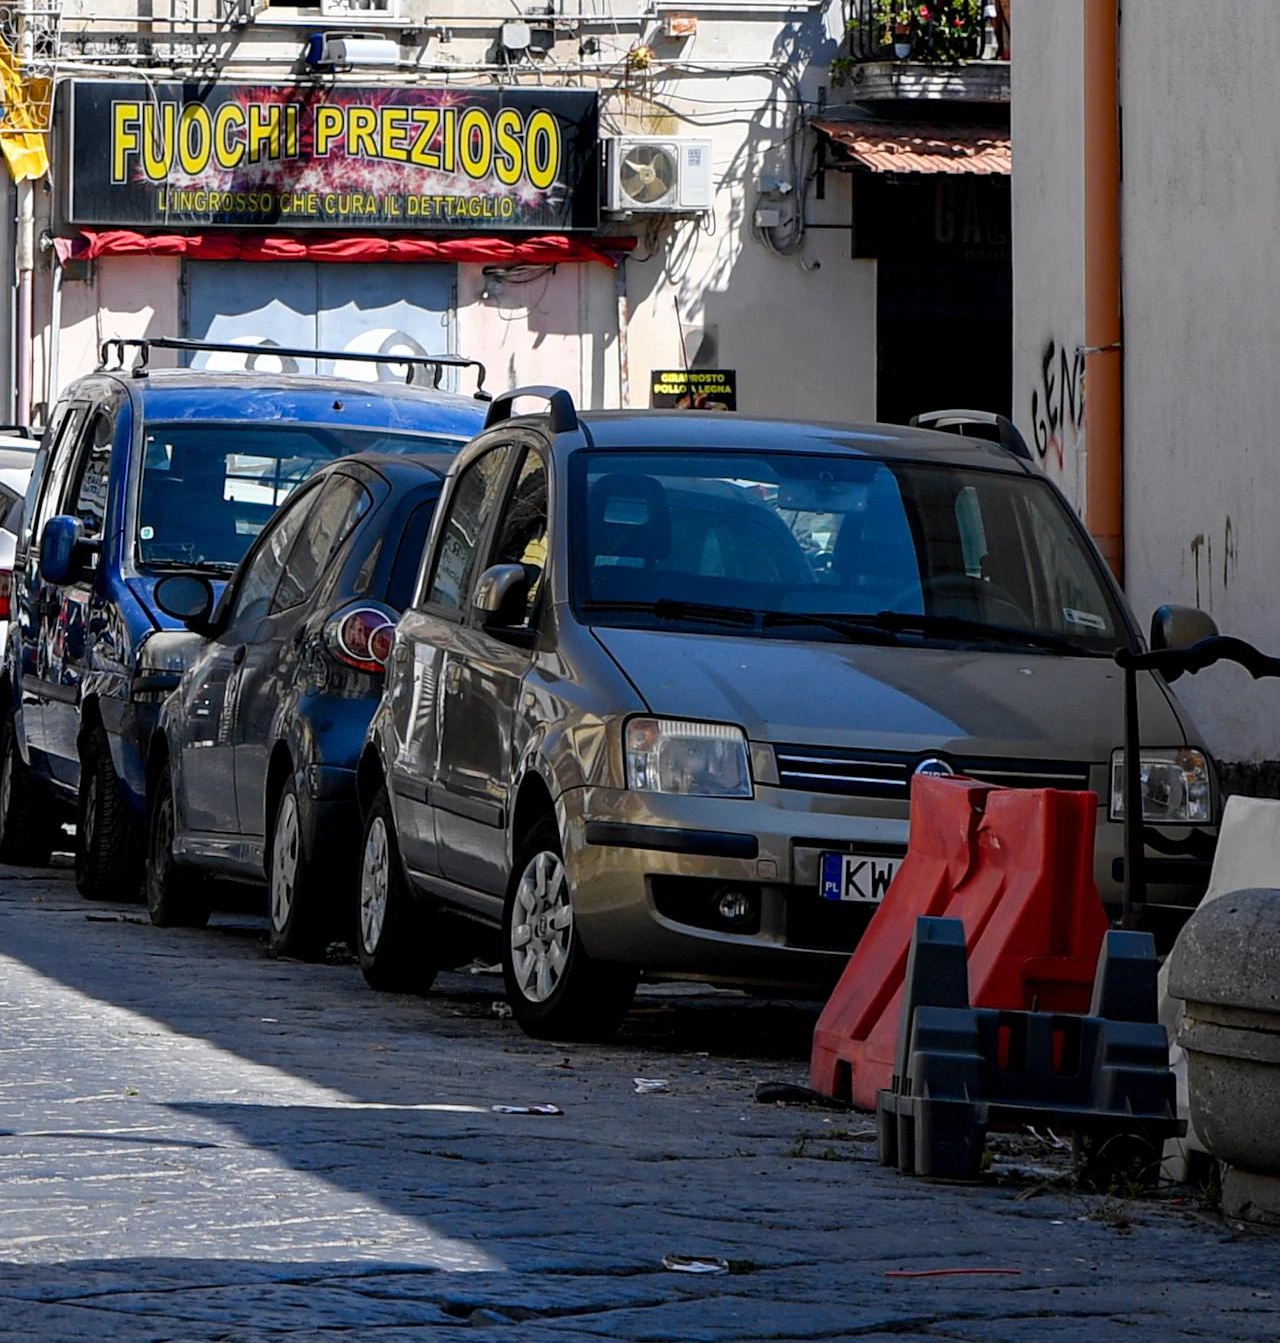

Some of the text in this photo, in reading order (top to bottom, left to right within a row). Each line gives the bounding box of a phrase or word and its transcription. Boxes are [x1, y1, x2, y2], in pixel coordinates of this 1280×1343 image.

[110, 99, 562, 191] FUOCHI PREZIOSO
[158, 190, 514, 217] L'INGROSSO CHE CURA IL DETTAGLIO
[653, 384, 687, 394] POLLO
[698, 385, 732, 394] LEGNA
[824, 881, 840, 893] PL
